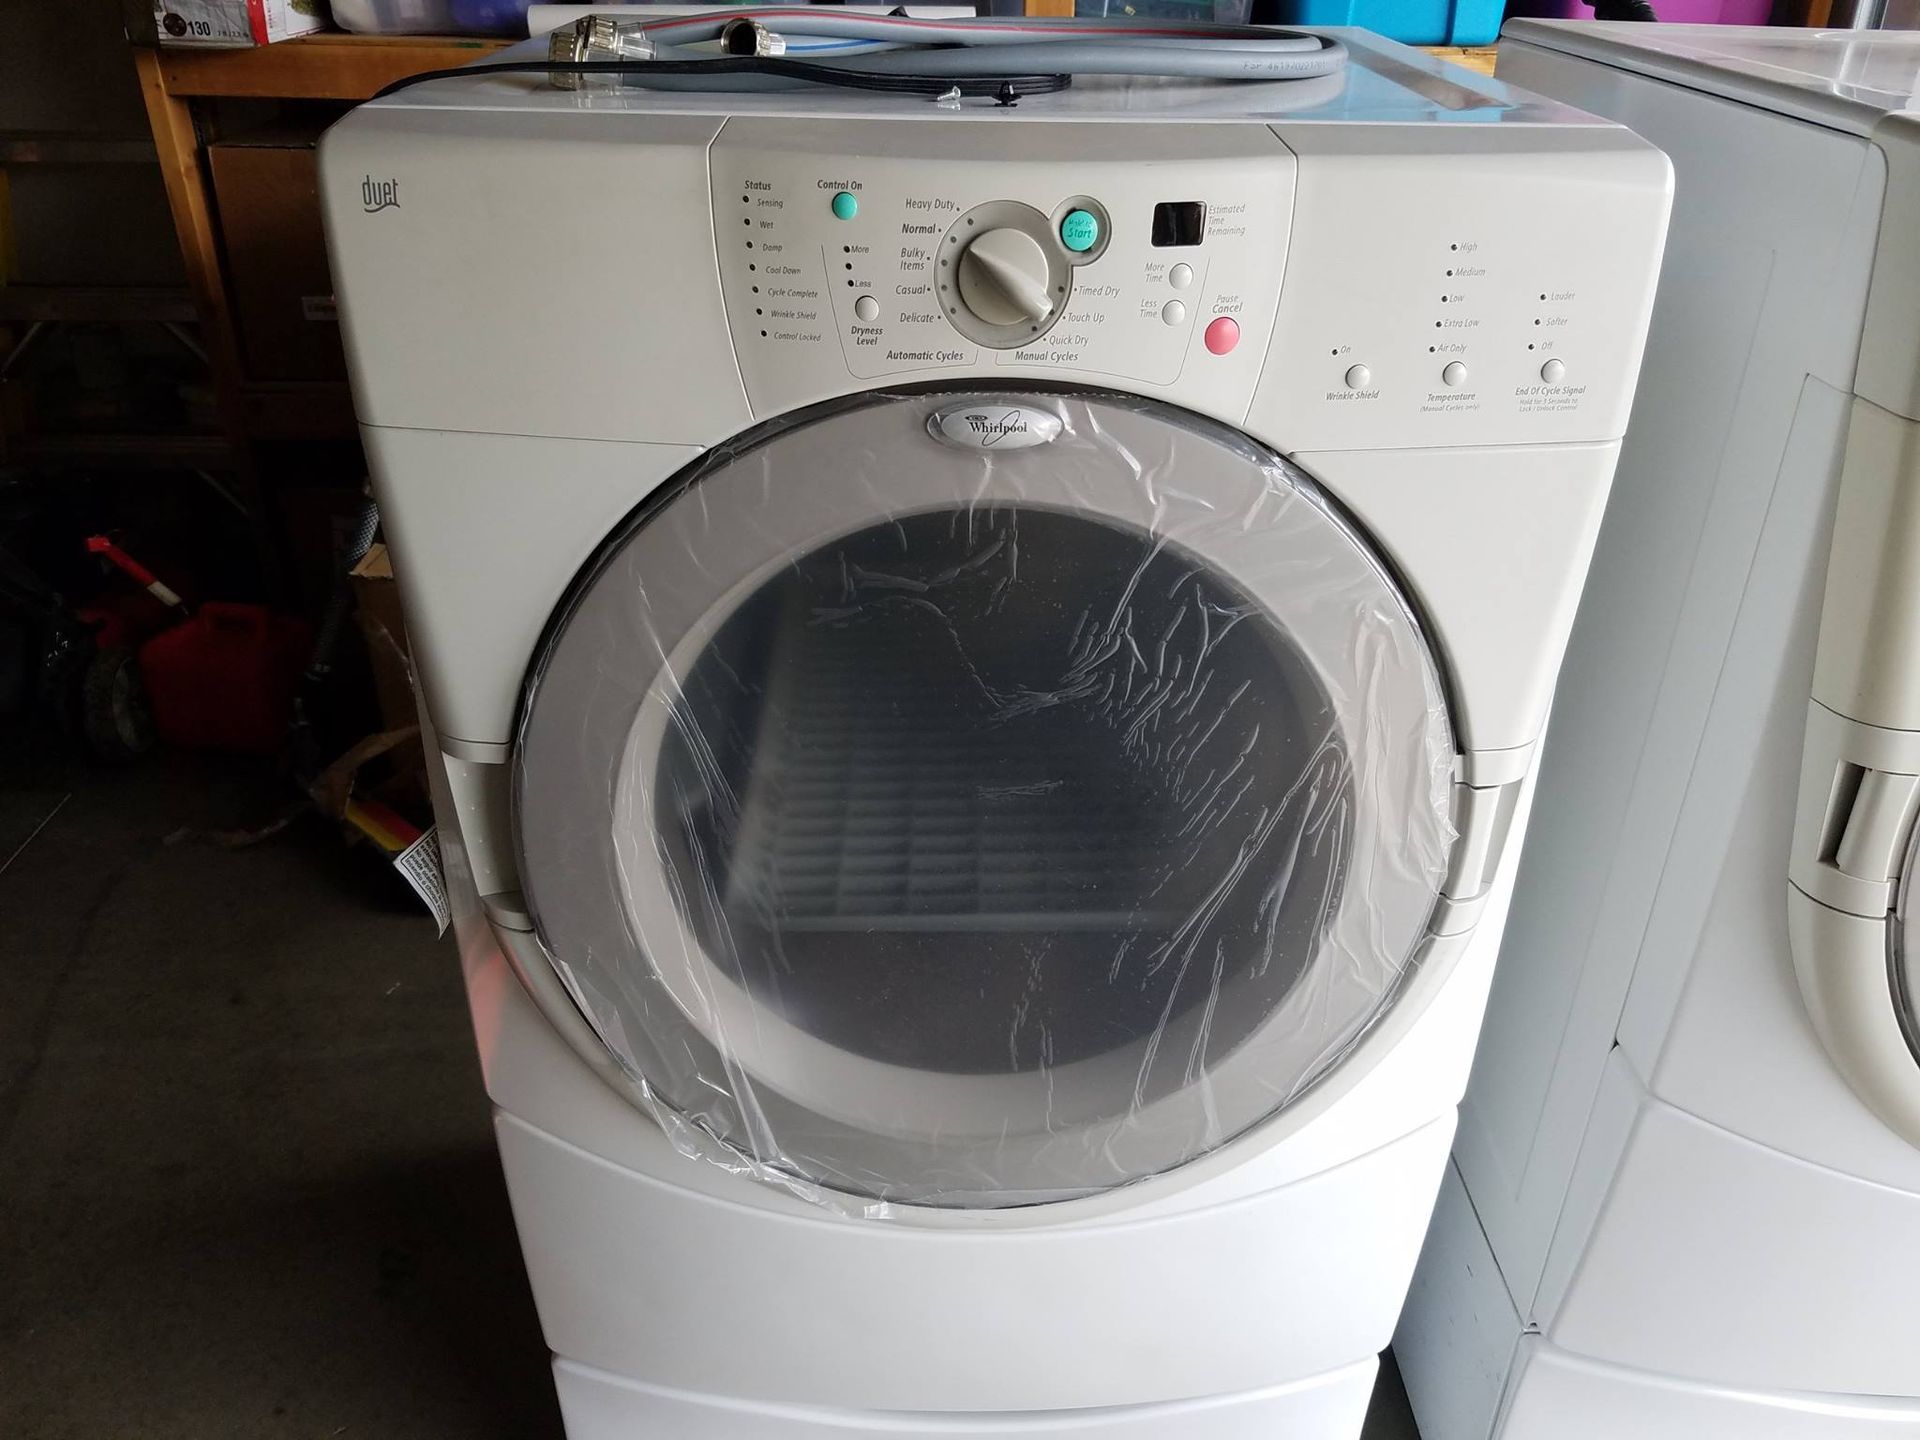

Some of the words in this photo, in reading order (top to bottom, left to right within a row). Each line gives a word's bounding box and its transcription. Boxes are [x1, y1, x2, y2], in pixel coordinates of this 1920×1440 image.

[188, 21, 211, 37] 130
[745, 180, 772, 191] Status
[817, 180, 848, 190] Control
[851, 182, 862, 190] On
[362, 174, 400, 213] duet
[757, 198, 784, 208] Sensing
[906, 198, 932, 211] Heavy
[934, 199, 955, 212] Duty
[1208, 204, 1246, 214] Estimated
[760, 220, 774, 229] Wet
[1208, 216, 1225, 224] Time
[902, 224, 936, 234] Normal
[1068, 228, 1092, 238] Start
[1208, 226, 1246, 236] Remaining
[762, 244, 782, 252] Damp
[1460, 242, 1478, 252] High
[900, 248, 925, 260] Bulky
[766, 266, 781, 274] Cool
[783, 266, 802, 274] Down
[900, 261, 925, 271] Items
[1144, 262, 1165, 272] More
[1455, 268, 1486, 276] Medium
[1146, 274, 1162, 282] Time
[854, 280, 872, 288] Less
[768, 288, 785, 298] Cycle
[787, 288, 818, 298] Complete
[895, 285, 926, 295] Casual
[1078, 286, 1104, 296] Timed
[1104, 286, 1120, 298] Dry
[1449, 294, 1464, 302] Low
[1551, 292, 1576, 300] Louder
[1140, 299, 1157, 308] Less
[1212, 302, 1244, 314] Cancel
[771, 310, 795, 318] Wrinkle
[796, 311, 816, 320] Shield
[900, 313, 934, 323] Delicate
[1067, 313, 1090, 322] Touch
[1092, 314, 1104, 324] Up
[1140, 309, 1158, 318] Time
[1444, 318, 1462, 328] Extra
[1464, 318, 1480, 328] Low
[1546, 317, 1568, 326] Softer
[851, 326, 884, 336] Dryness
[774, 332, 798, 340] Control
[800, 332, 821, 342] Locked
[856, 336, 878, 346] Level
[1049, 335, 1073, 345] Quick
[1074, 335, 1089, 347] Dry
[1340, 346, 1351, 354] On
[1436, 344, 1449, 352] Air
[1450, 344, 1467, 354] Only
[1541, 342, 1552, 350] Off
[886, 350, 934, 360] Automatic
[936, 351, 964, 362] Cycles
[1015, 351, 1048, 361] Manual
[1050, 352, 1078, 362] Cycles
[1326, 392, 1354, 400] Wrinkle
[1355, 390, 1380, 400] Shield
[1515, 387, 1530, 396] End
[1530, 386, 1540, 395] Of
[1541, 386, 1562, 396] Cycle
[1562, 386, 1586, 396] Signal
[1427, 394, 1476, 402] Temperature
[969, 421, 1028, 435] Whirlpool
